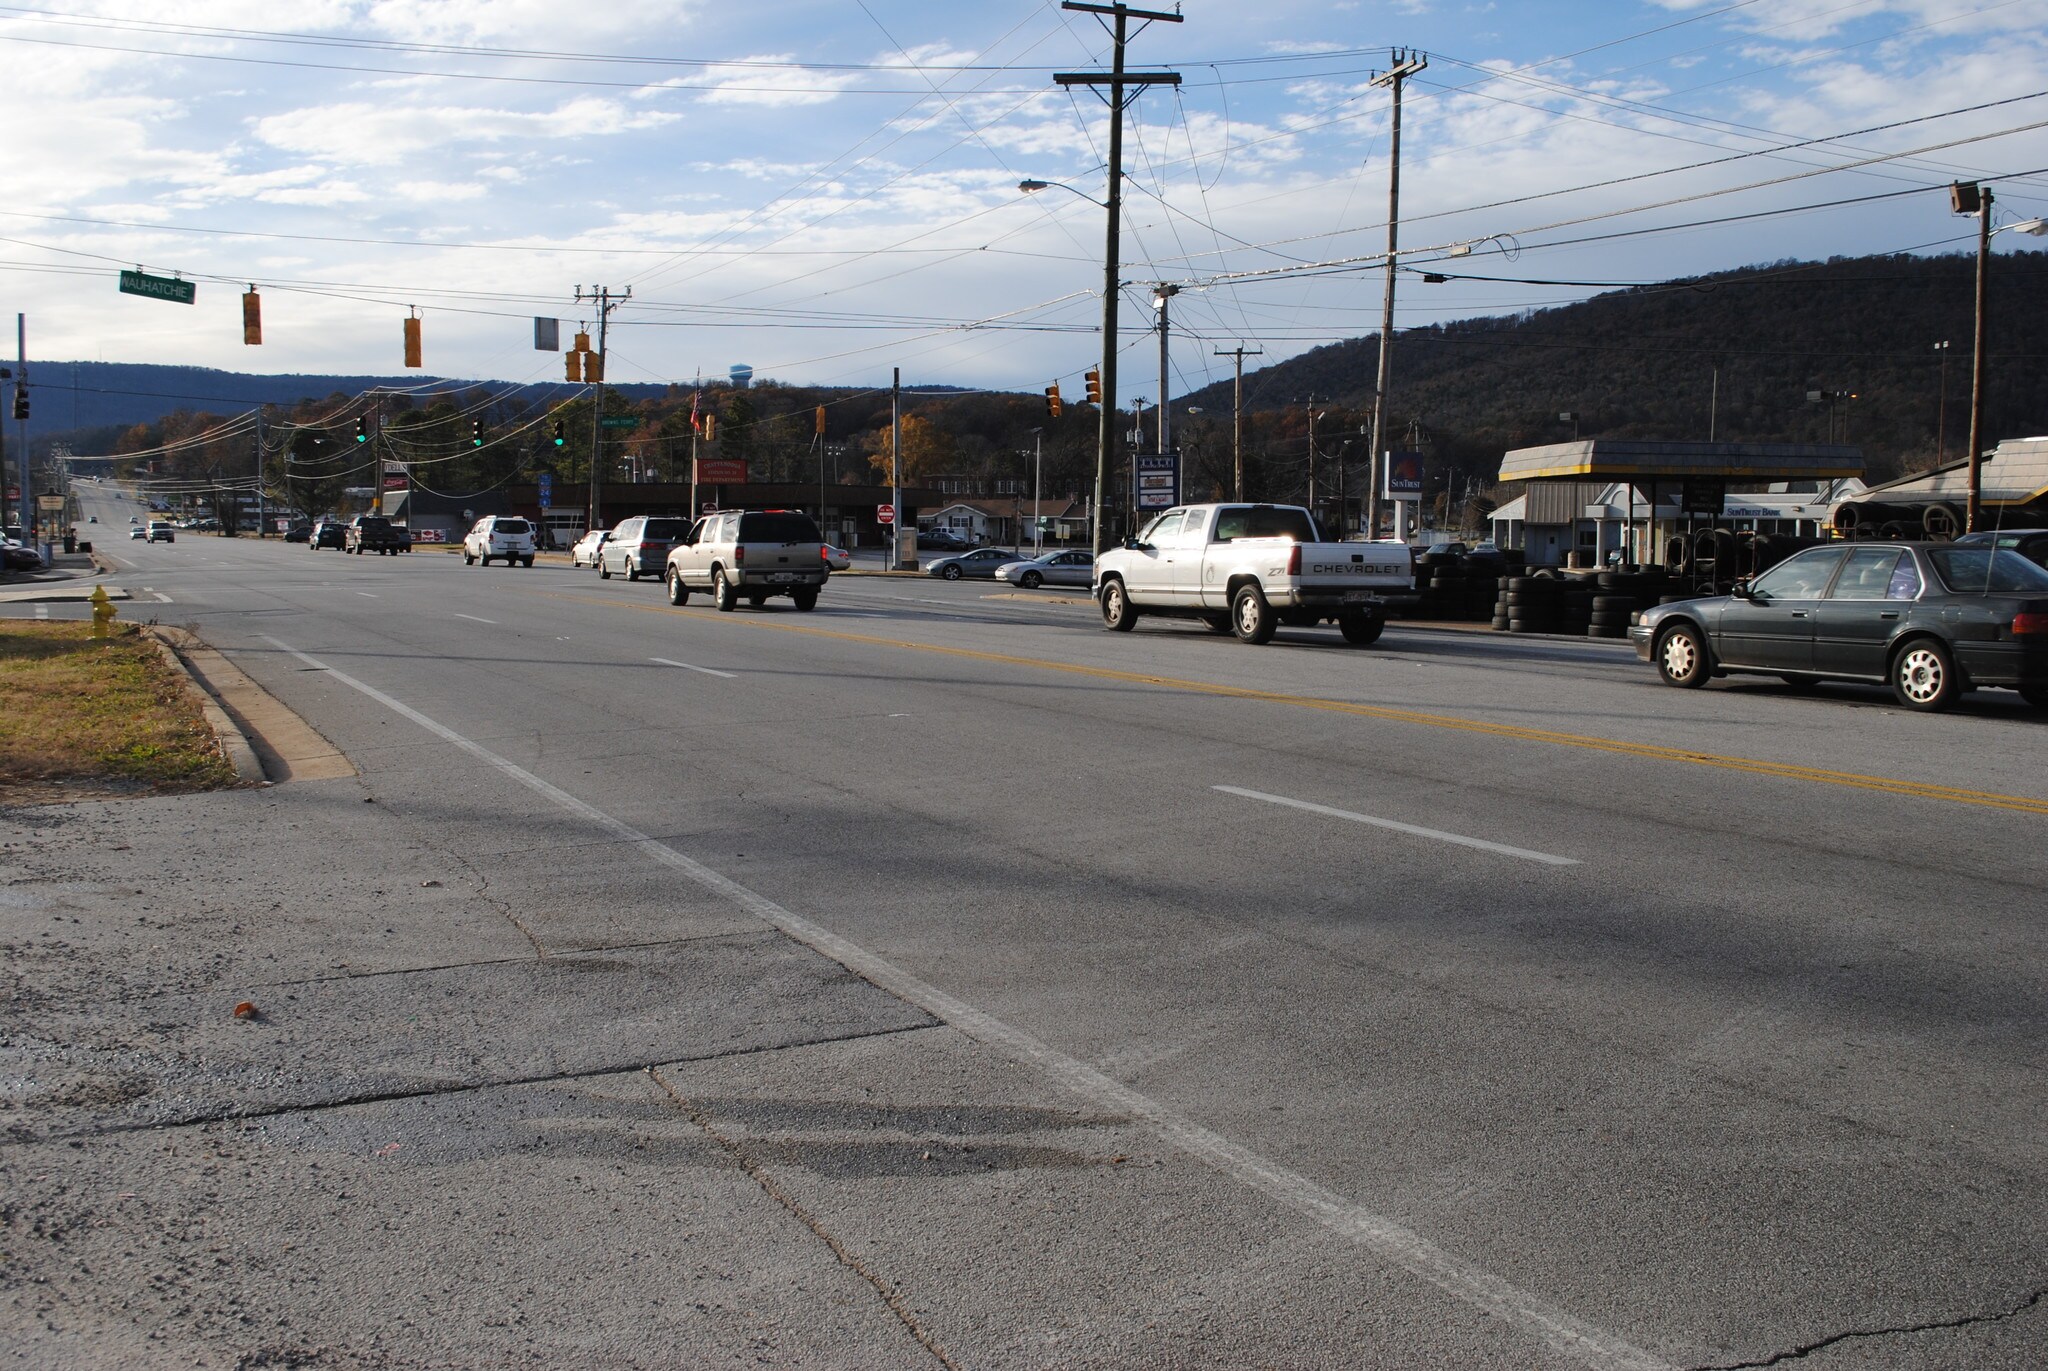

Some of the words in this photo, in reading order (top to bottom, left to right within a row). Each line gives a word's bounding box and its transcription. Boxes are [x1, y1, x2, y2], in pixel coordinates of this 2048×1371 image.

[121, 276, 188, 298] WAUHATCHIE
[1762, 508, 1781, 516] BANK
[1267, 567, 1285, 577] Z71
[1313, 564, 1401, 574] CHEVROLET
